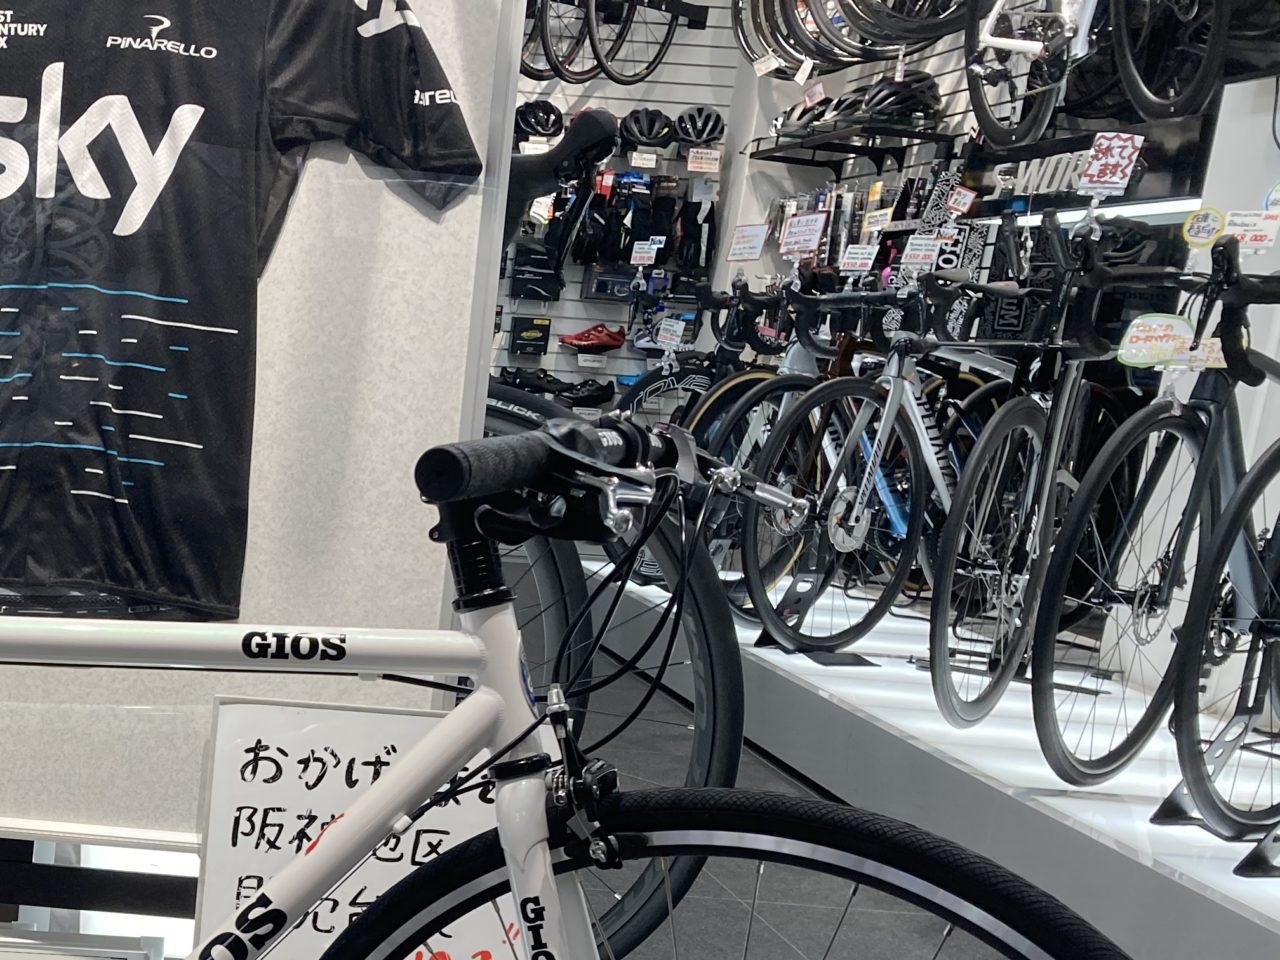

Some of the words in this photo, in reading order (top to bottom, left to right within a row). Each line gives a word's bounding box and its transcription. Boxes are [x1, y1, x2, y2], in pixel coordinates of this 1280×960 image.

[106, 35, 218, 59] PINARELLO
[983, 150, 1091, 201] S-WOR
[241, 631, 347, 661] GIOS
